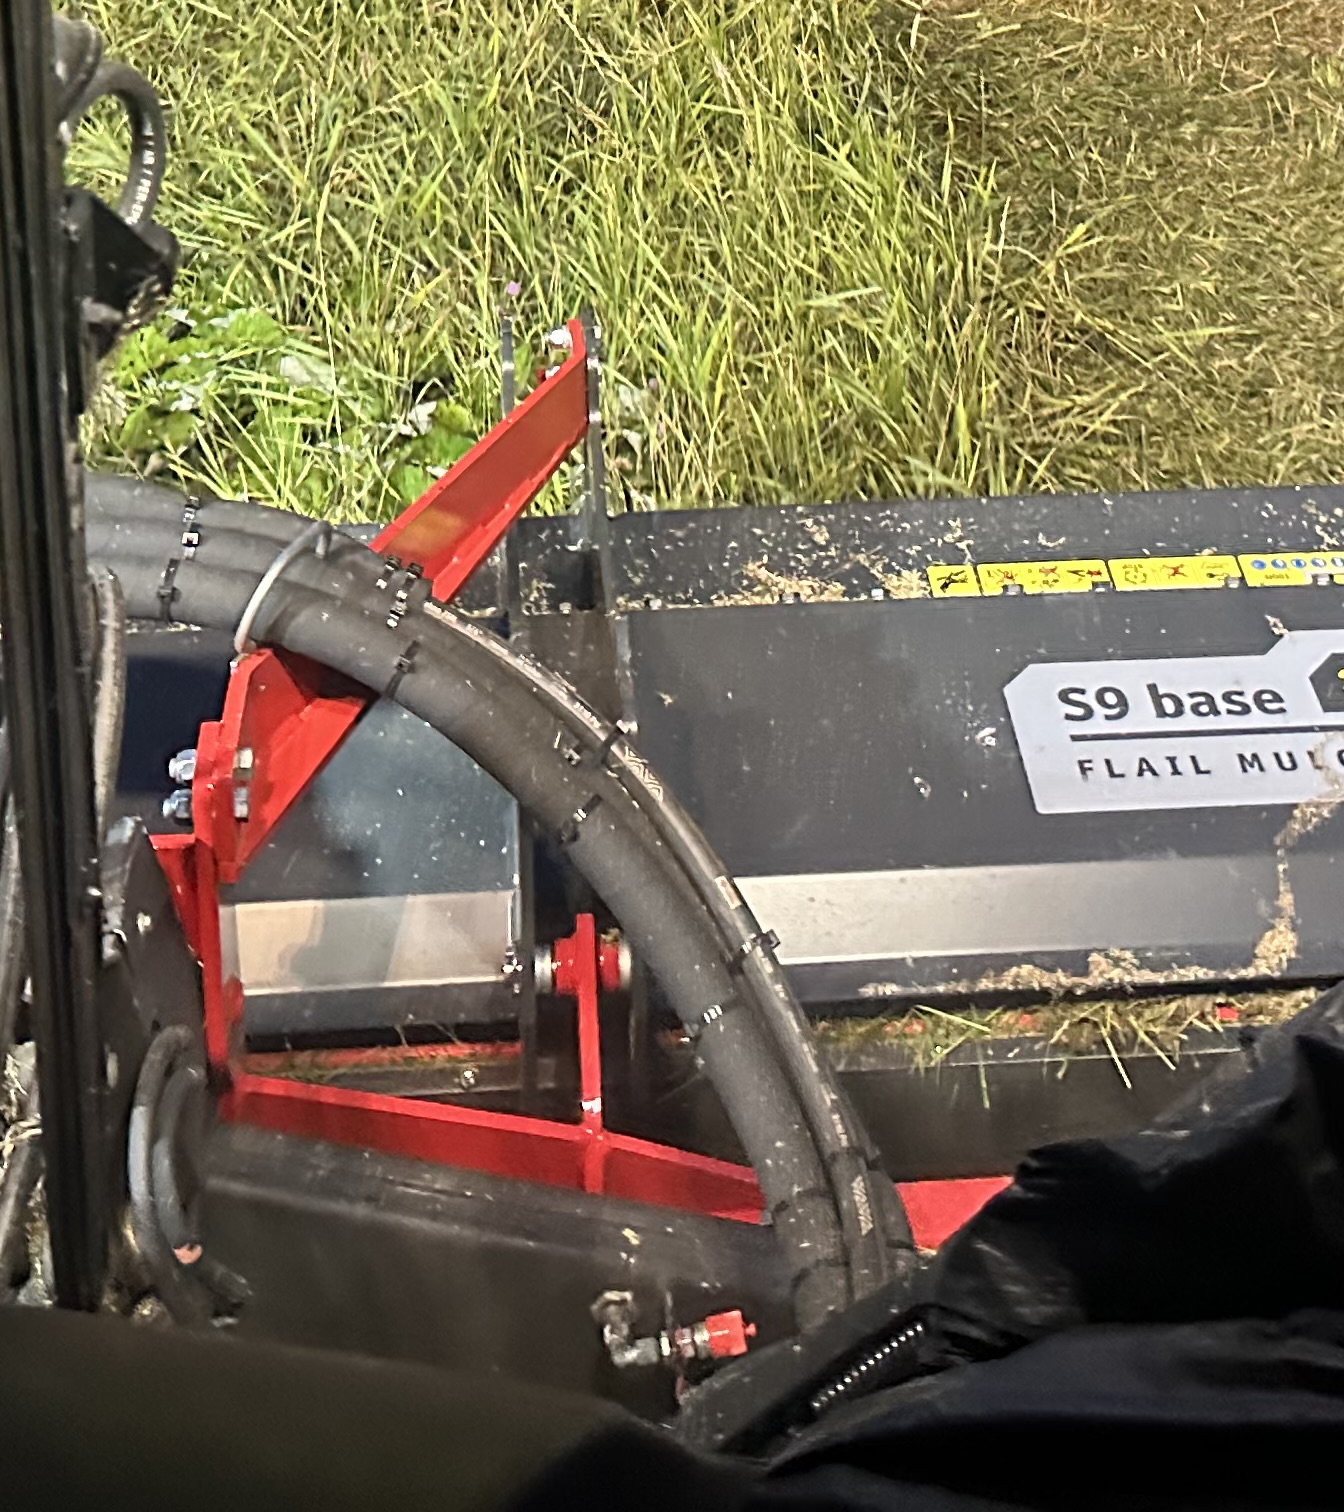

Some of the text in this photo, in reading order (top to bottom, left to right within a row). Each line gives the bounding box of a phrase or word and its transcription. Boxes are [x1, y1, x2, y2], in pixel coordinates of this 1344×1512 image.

[1057, 686, 1130, 722] S9
[1146, 682, 1288, 719] base
[1077, 754, 1212, 782] FLAIL
